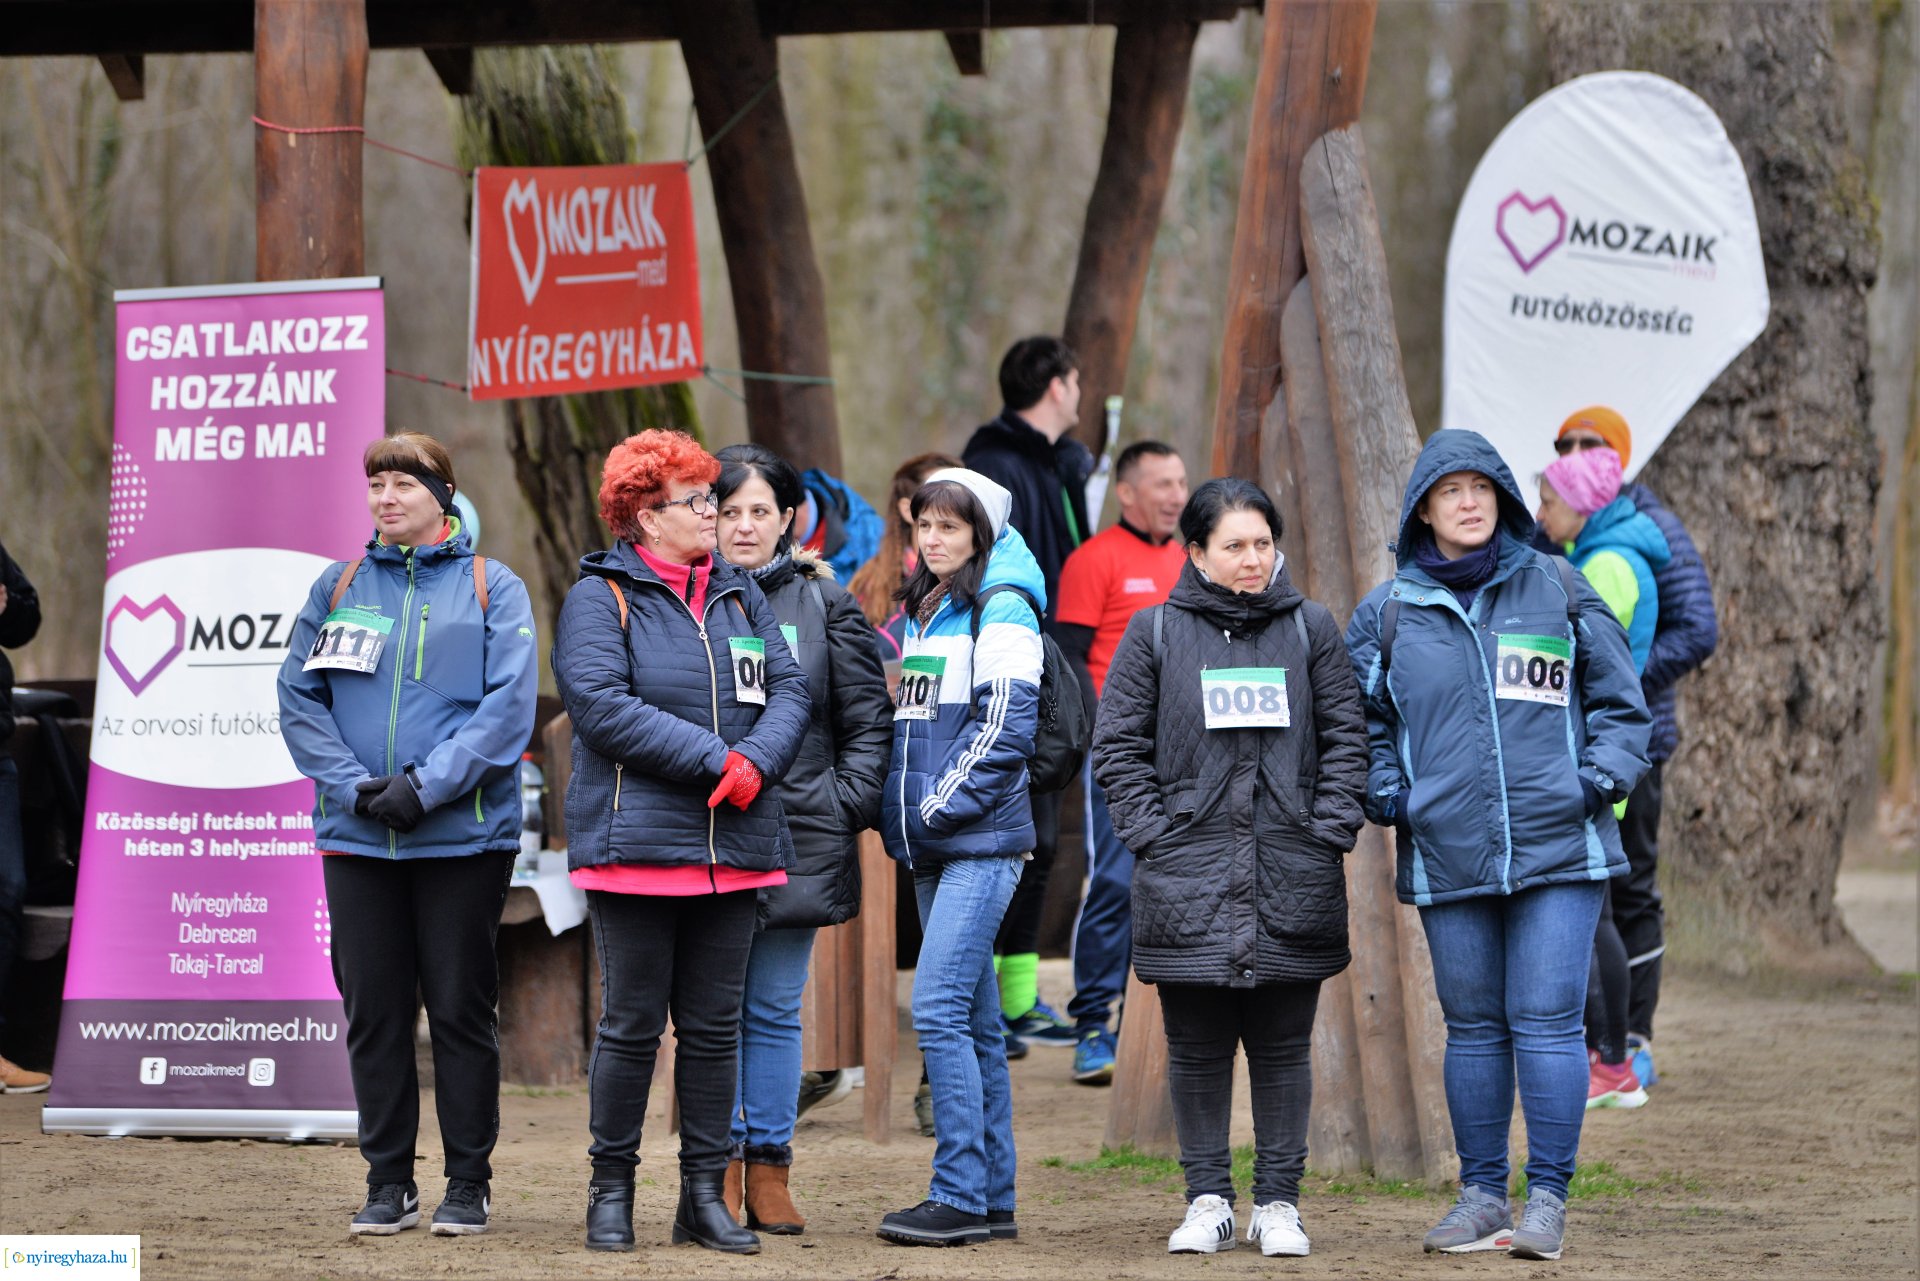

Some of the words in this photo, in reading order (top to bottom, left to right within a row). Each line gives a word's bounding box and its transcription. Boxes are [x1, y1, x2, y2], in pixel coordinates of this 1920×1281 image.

[546, 183, 668, 256] MOZAIK
[1569, 216, 1718, 263] MOZAIK
[1510, 293, 1695, 335] FUTÓKÖZÖSSÉG
[125, 315, 369, 362] CSATLAKOZZ
[471, 314, 698, 388] NYÍREGYHÁZA
[150, 361, 338, 411] HOZZÁNK
[154, 416, 246, 462] MÉG
[254, 421, 327, 459] MA!
[312, 626, 368, 657] 011
[1502, 653, 1565, 691] 006
[1208, 685, 1282, 715] 008
[99, 715, 124, 736] Az
[131, 713, 204, 736] orvosi
[95, 811, 199, 835] Közösségi
[203, 811, 278, 831] futások
[124, 838, 185, 857] héten
[189, 838, 205, 857] 3
[209, 837, 316, 861] helyszínen:
[171, 892, 269, 918] Nyíregyháza
[178, 922, 257, 944] Debrecen
[168, 953, 264, 979] Tokaj-Tarcal
[79, 1017, 338, 1042] www.mozaikmed.hu
[169, 1062, 246, 1078] mozaikmed
